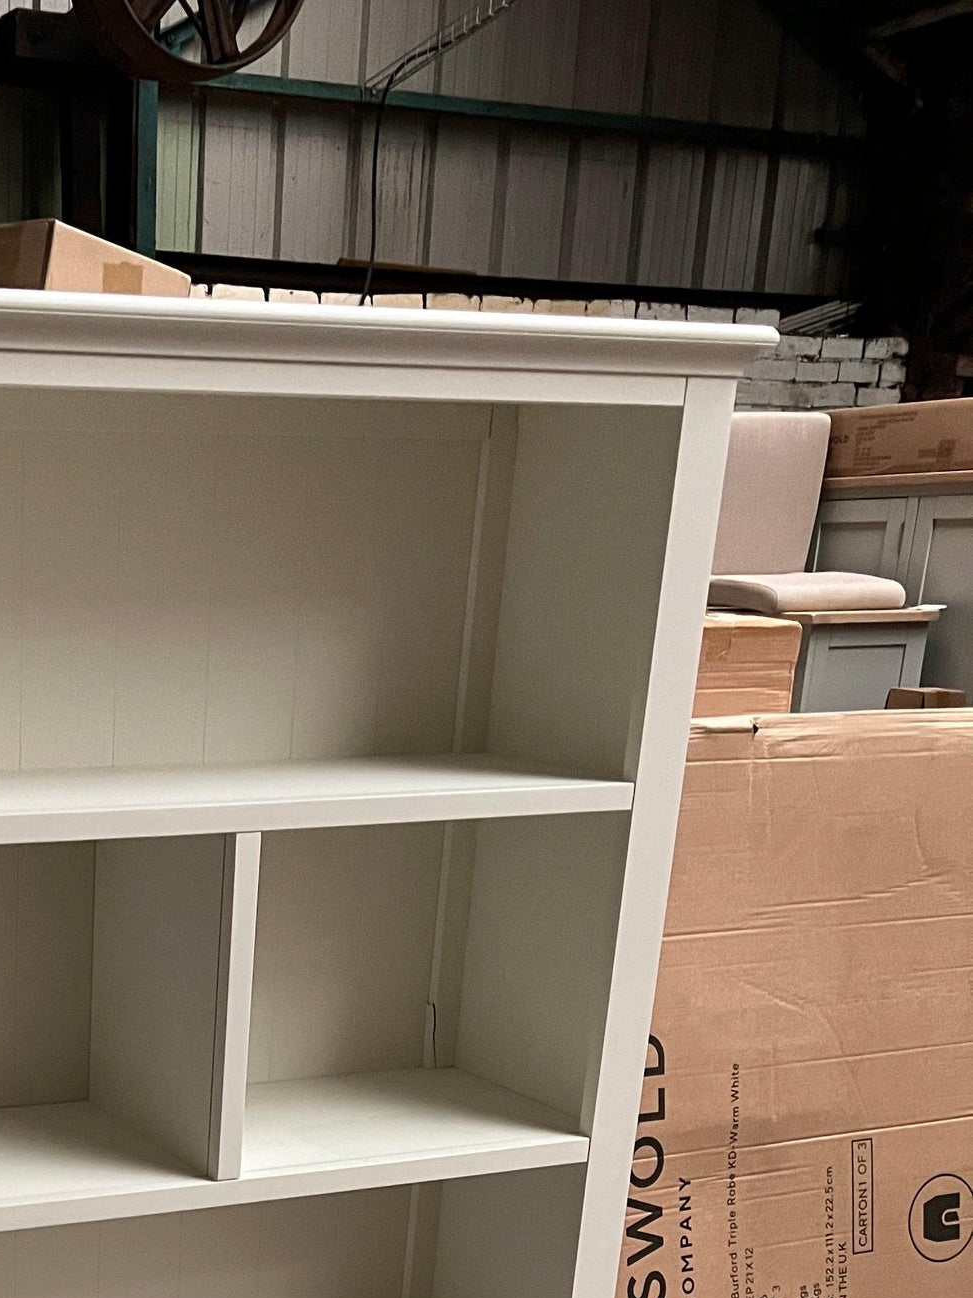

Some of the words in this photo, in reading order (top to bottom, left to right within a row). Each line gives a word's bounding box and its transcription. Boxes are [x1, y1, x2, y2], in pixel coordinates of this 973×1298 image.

[731, 1063, 739, 1103] White
[858, 1156, 867, 1174] OF
[727, 1173, 736, 1205] Robe
[728, 1211, 737, 1247] Triple
[838, 1242, 846, 1264] U.K
[729, 1252, 740, 1298] Burford
[839, 1267, 847, 1291] THE
